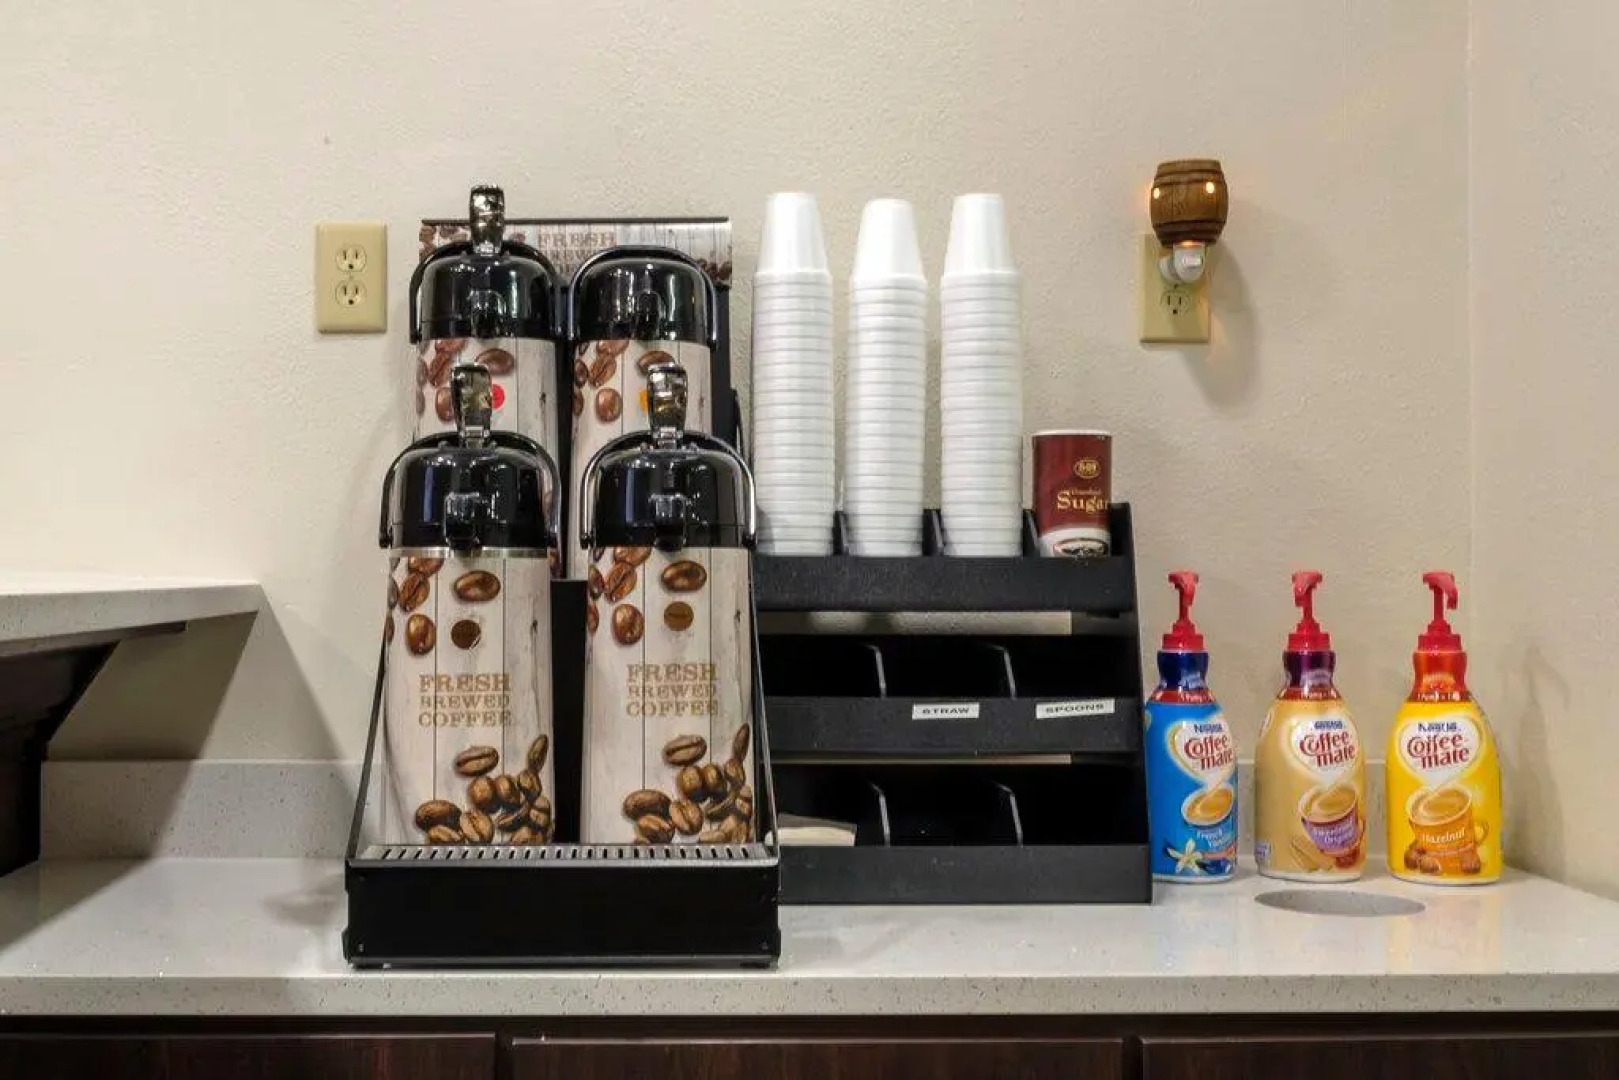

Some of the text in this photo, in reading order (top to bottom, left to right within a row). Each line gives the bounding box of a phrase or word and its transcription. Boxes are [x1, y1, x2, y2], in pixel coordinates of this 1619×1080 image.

[538, 233, 617, 248] FRESH
[627, 663, 718, 681] FRESH
[419, 673, 511, 692] FRESH
[628, 684, 718, 699] BREWED
[420, 695, 511, 709] BREWED
[626, 700, 719, 717] COFFEE
[921, 706, 970, 714] STRAW
[1045, 703, 1105, 715] SPOONS
[418, 711, 512, 727] COFFEE
[1184, 735, 1228, 760] Coffee
[1300, 731, 1350, 757] Coffee
[1407, 734, 1463, 758] Coffee
[1201, 749, 1233, 770] mate
[1316, 745, 1356, 768] mate
[1420, 747, 1470, 770] mate
